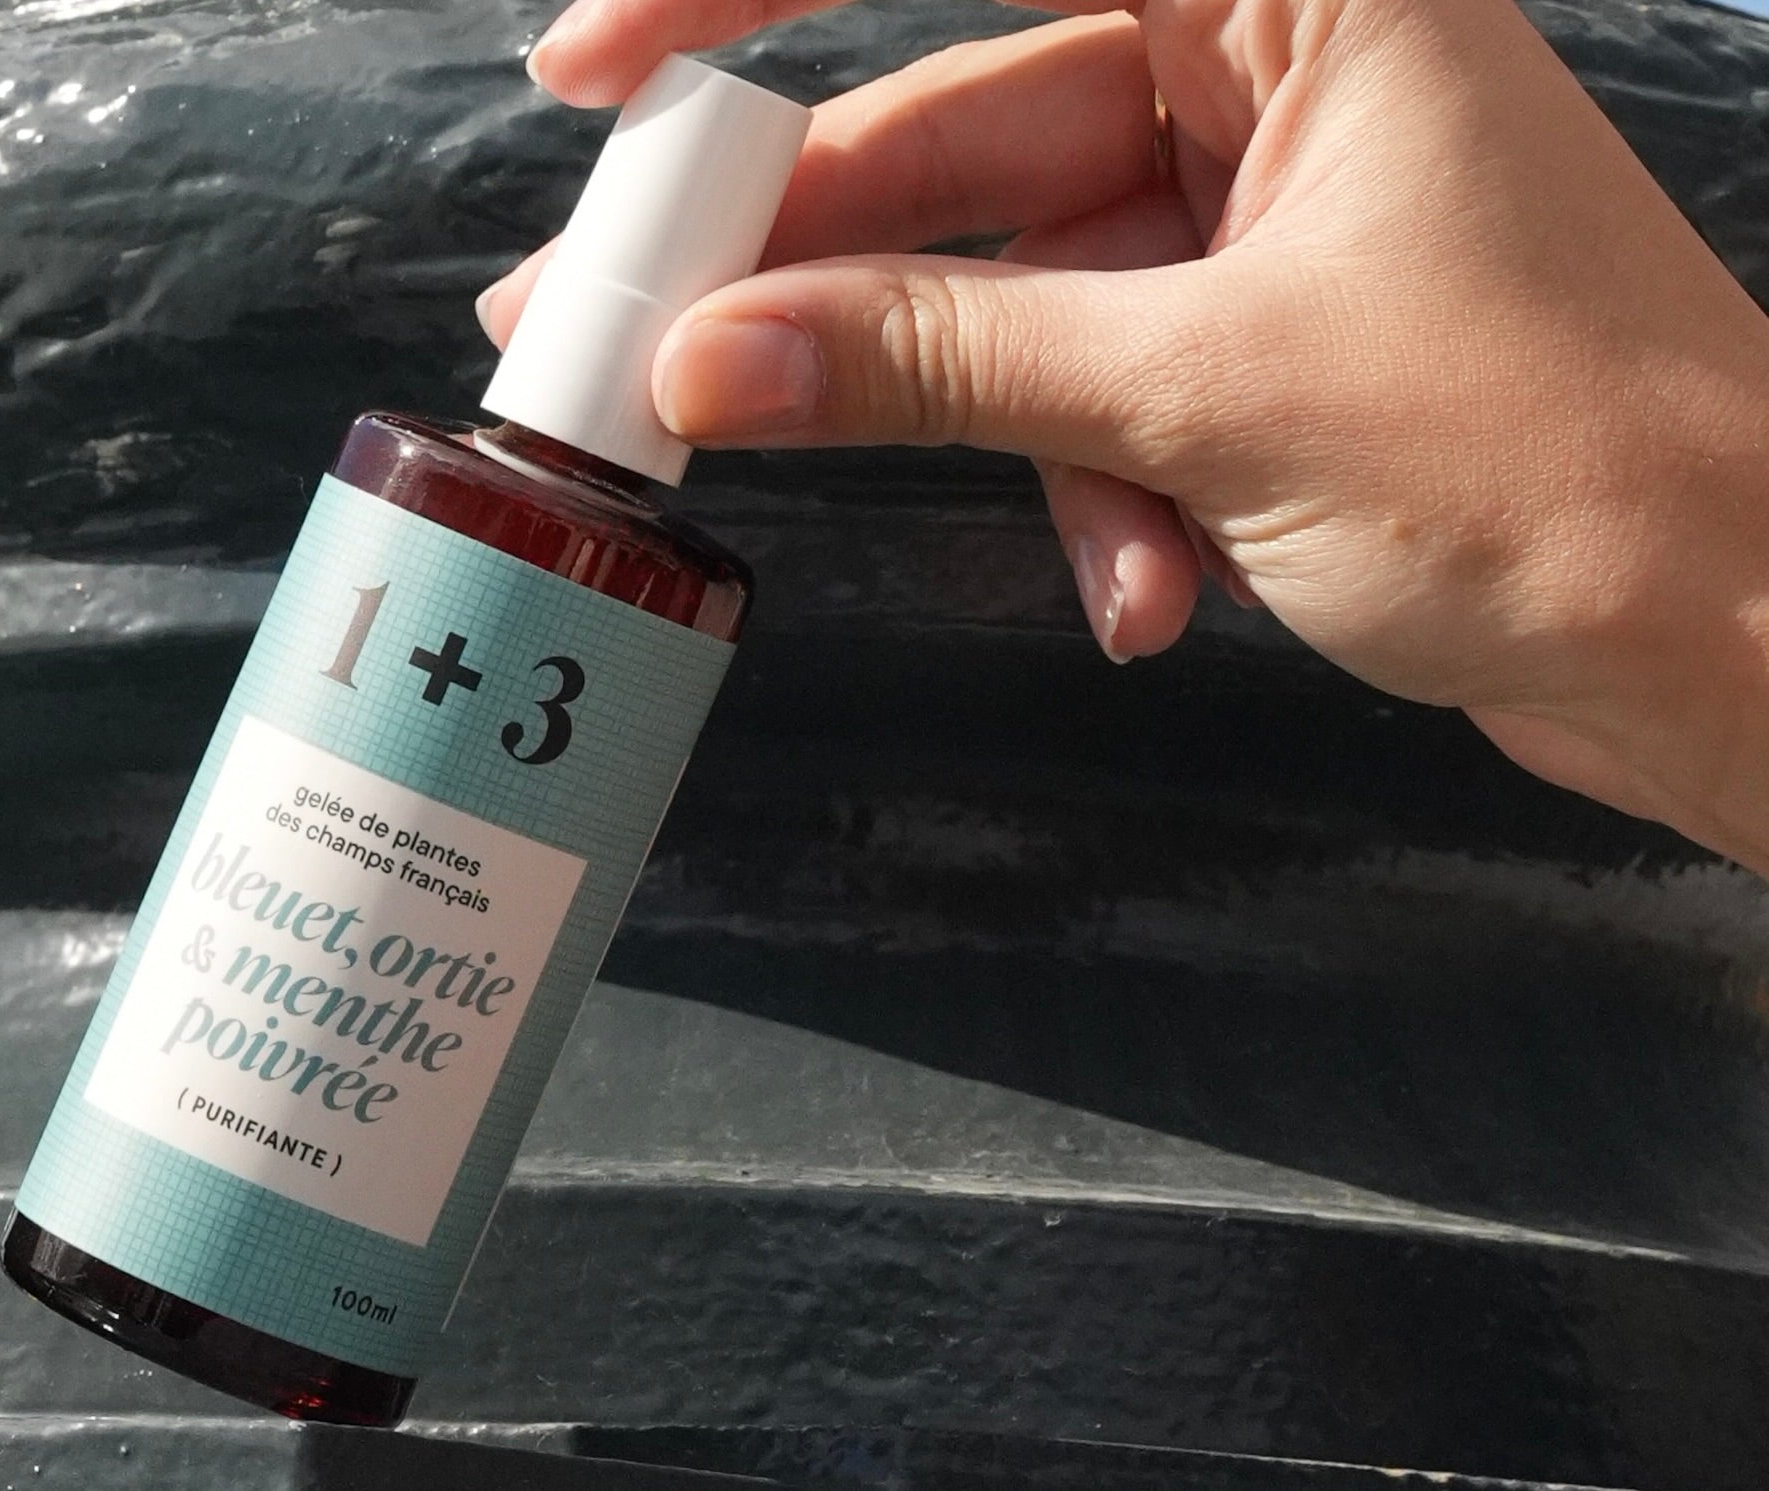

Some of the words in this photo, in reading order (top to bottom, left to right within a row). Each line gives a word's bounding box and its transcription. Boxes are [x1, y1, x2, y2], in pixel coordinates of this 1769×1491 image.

[318, 581, 391, 691] 1
[408, 631, 483, 707] +
[501, 656, 585, 765] 3
[265, 803, 302, 832] des
[306, 823, 395, 874] champs
[399, 860, 491, 913] français
[293, 785, 355, 823] gelée
[358, 812, 390, 838] de
[392, 828, 482, 877] plantes
[181, 924, 217, 973] &
[222, 946, 463, 1073] menthe
[369, 934, 516, 1016] ortie
[159, 996, 399, 1124] poivrée
[332, 1285, 398, 1325] 100ml
